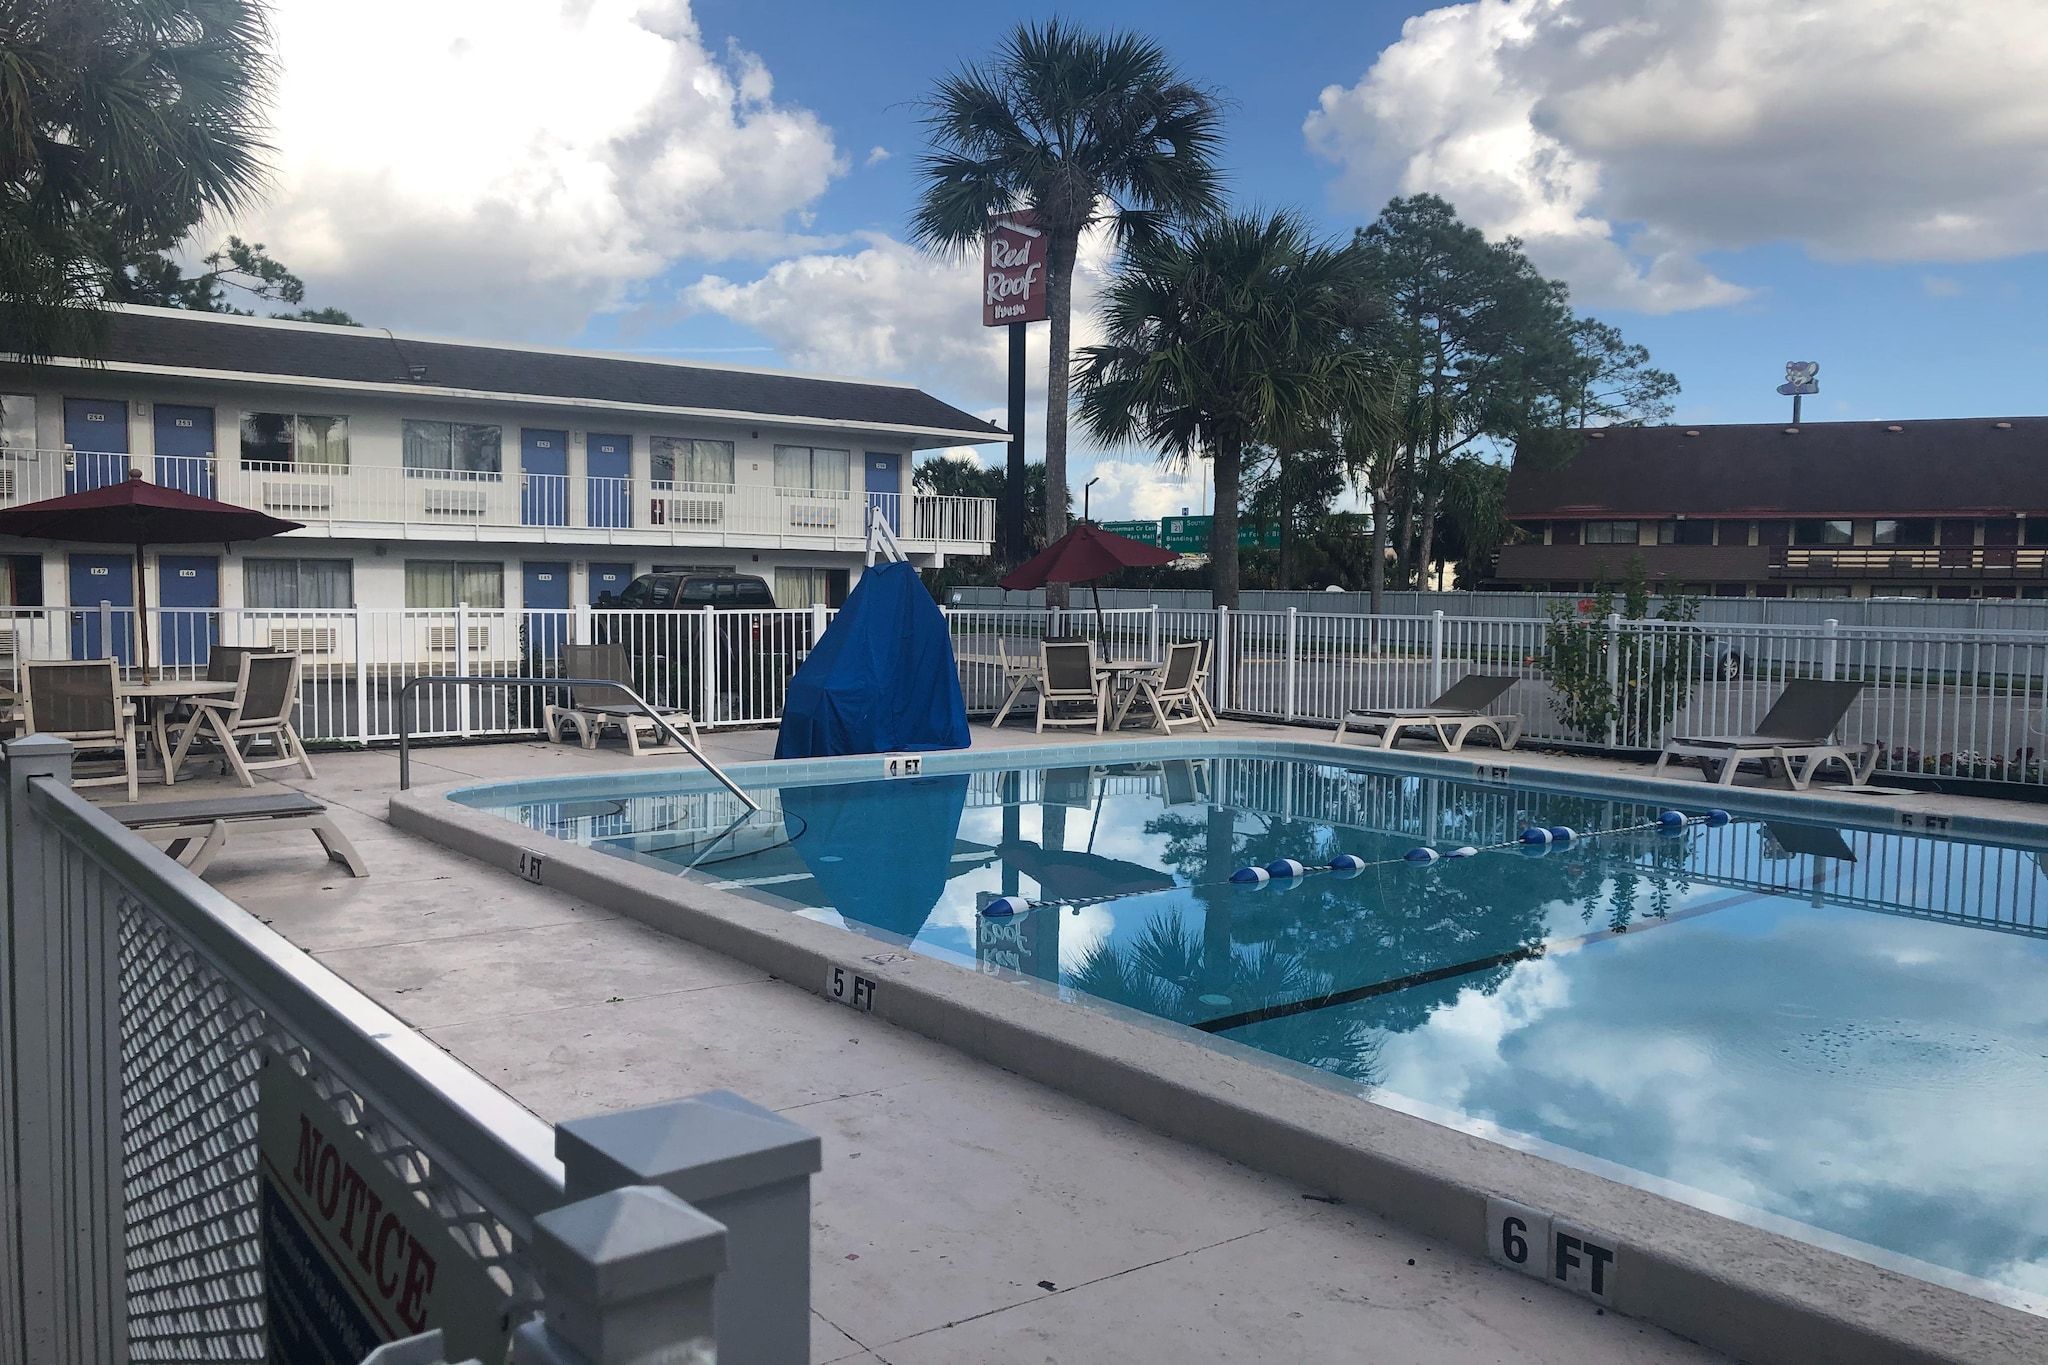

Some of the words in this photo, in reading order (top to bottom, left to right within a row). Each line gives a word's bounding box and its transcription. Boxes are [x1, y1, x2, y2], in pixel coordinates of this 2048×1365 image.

[991, 239, 1031, 269] Red
[986, 262, 1041, 305] Roof
[1166, 535, 1193, 543] Blanding
[92, 567, 106, 575] 147
[181, 569, 194, 577] 146
[889, 760, 897, 776] 4
[904, 759, 920, 775] FT
[1925, 815, 1949, 831] FT
[519, 853, 526, 873] 4
[530, 856, 542, 880] FT
[833, 967, 844, 997] 5
[853, 975, 876, 1011] FT
[293, 1113, 437, 1334] NOTICE
[1502, 1216, 1528, 1263] 6
[1556, 1231, 1614, 1296] FT
